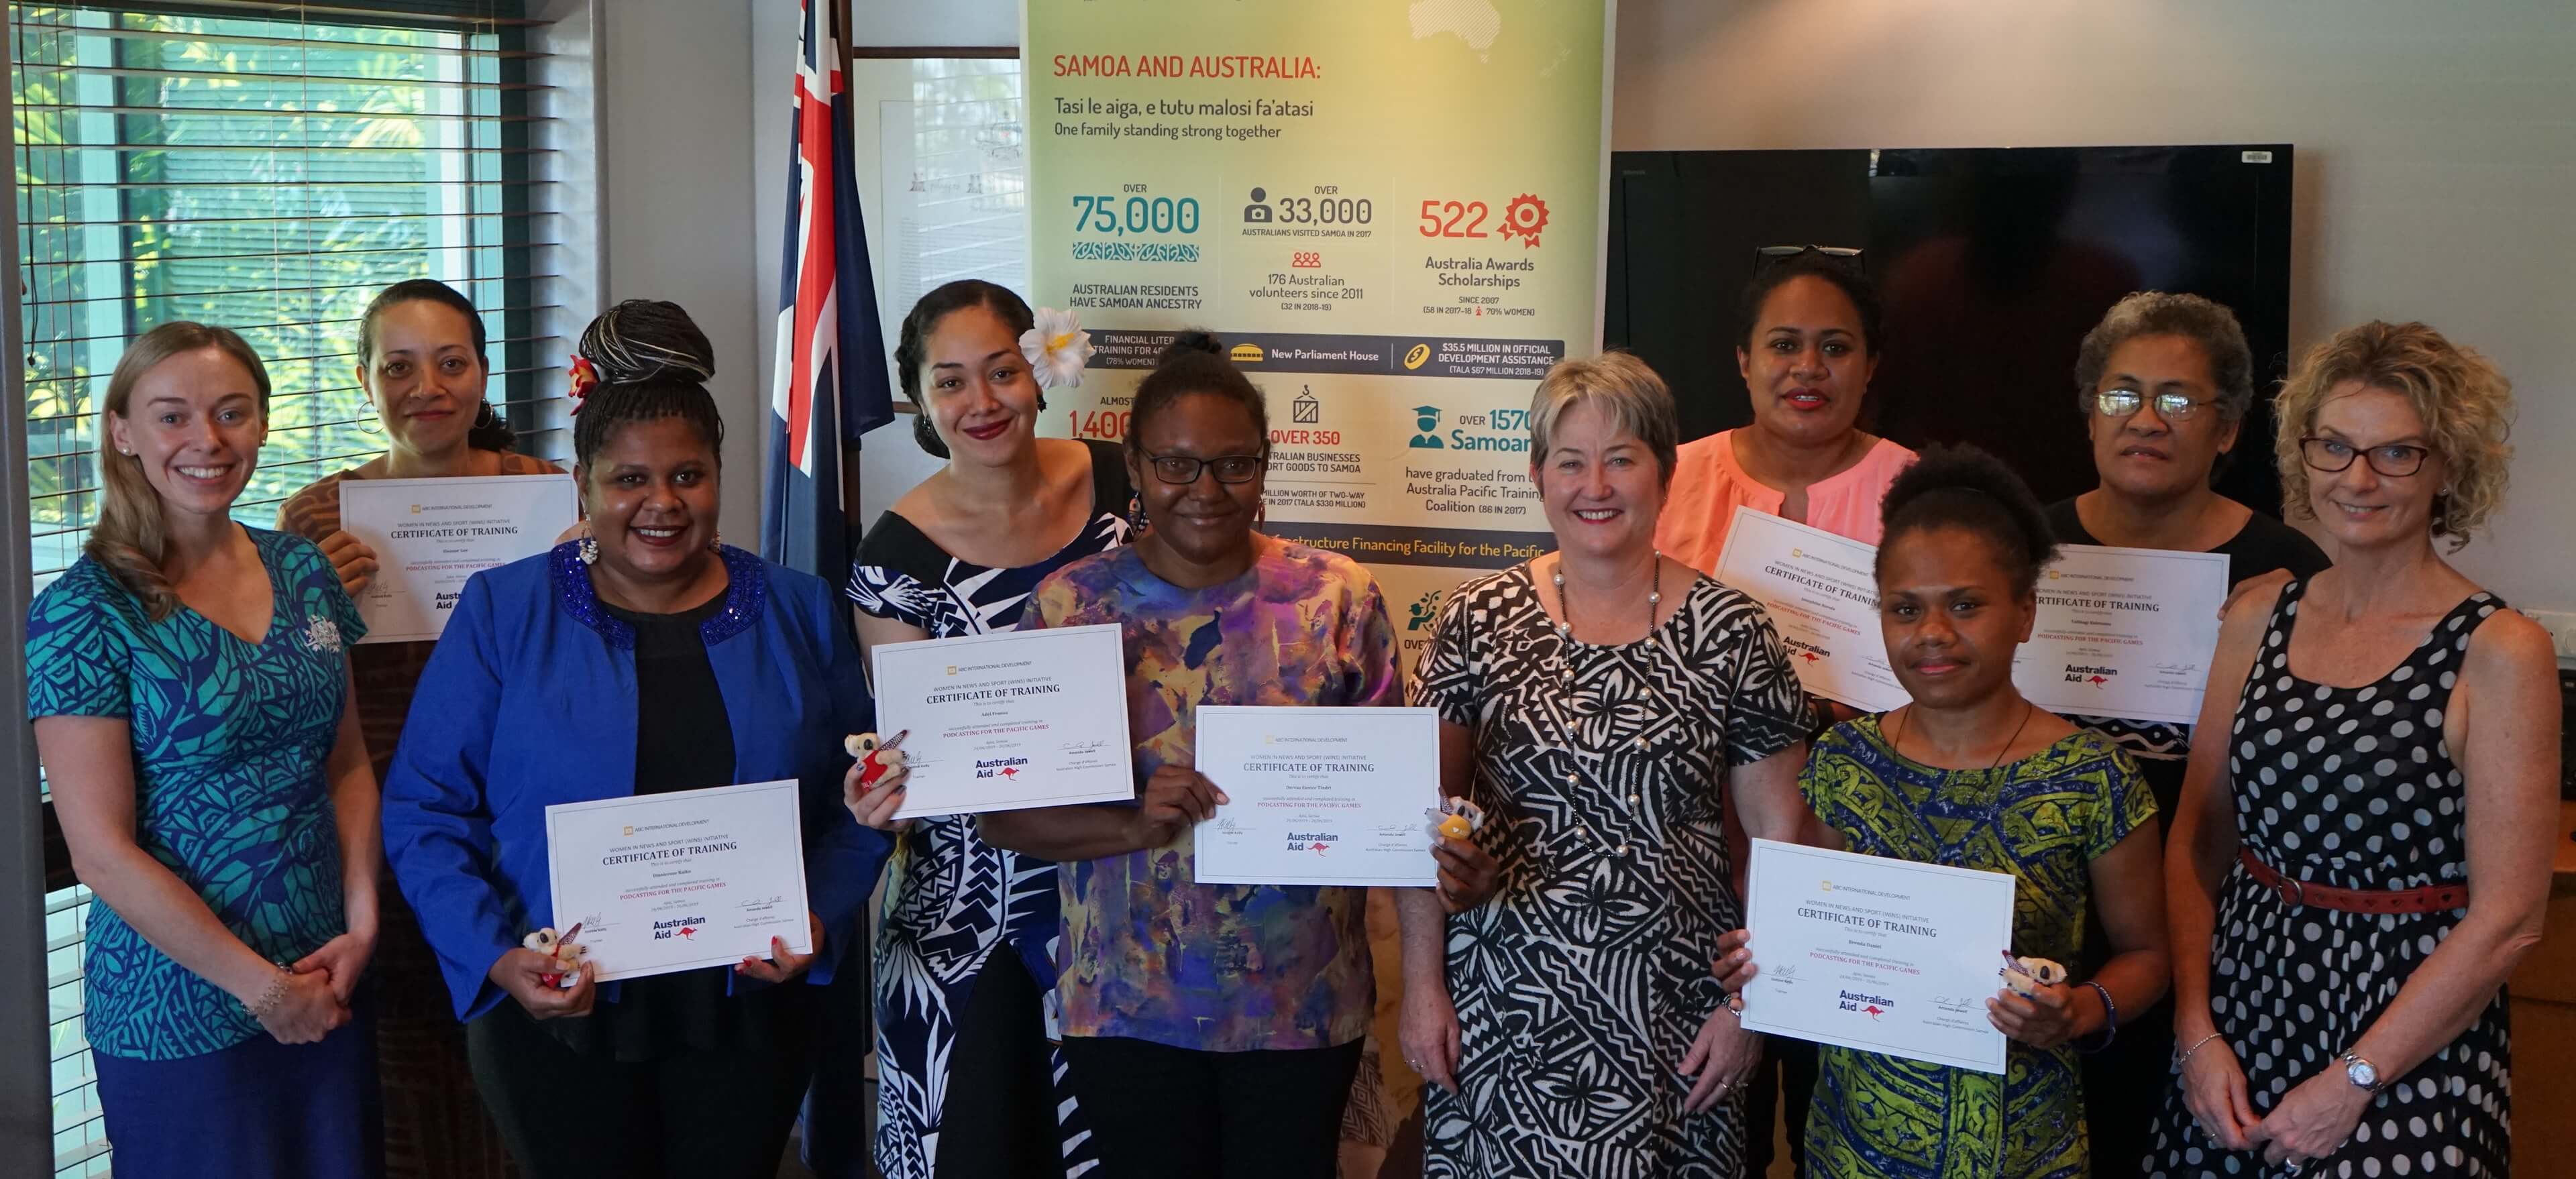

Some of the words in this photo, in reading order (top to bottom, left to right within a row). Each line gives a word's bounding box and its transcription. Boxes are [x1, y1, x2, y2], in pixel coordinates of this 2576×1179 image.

[1054, 54, 1131, 76] SAMOA
[1136, 56, 1183, 78] AND
[1189, 56, 1320, 78] AUSTRALIA:
[1055, 97, 1083, 114] Tasi
[1088, 97, 1102, 114] le
[1106, 99, 1142, 119] aiga,
[1146, 103, 1156, 114] e
[1160, 99, 1194, 115] tutu
[1199, 99, 1251, 116] malosi
[1055, 122, 1078, 135] One
[1081, 122, 1120, 139] family
[1124, 123, 1179, 139] standing
[1182, 124, 1222, 140] strong
[1226, 125, 1281, 141] together
[1124, 184, 1147, 192] OVER
[1314, 186, 1338, 194] OVER
[1073, 196, 1199, 236] 75,000
[1279, 198, 1372, 225] 33,000
[1419, 201, 1488, 237] 522
[1426, 256, 1482, 269] Australia
[1486, 258, 1534, 271] Awards
[1268, 274, 1286, 284] 176
[1289, 274, 1344, 286] Australian
[1438, 273, 1520, 290] Scholarships
[1073, 284, 1138, 295] AUSTRALIAN
[1140, 286, 1198, 296] RESIDENTS
[1250, 286, 1307, 298] volunteers
[1311, 288, 1338, 298] since
[1342, 288, 1363, 299] 2011
[1070, 296, 1096, 307] HAVE
[1099, 298, 1143, 308] SAMOAN
[1146, 299, 1202, 309] ANCESTRY
[1481, 296, 1499, 304] 2007
[1106, 335, 1148, 344] FINANCIAL
[1151, 336, 1175, 345] LITER
[1094, 345, 1132, 354] TRAINING
[1442, 343, 1465, 352] $35.5
[1467, 344, 1499, 353] MILLION
[1503, 345, 1511, 353] IN
[1513, 345, 1550, 354] OFFICIAL
[1272, 349, 1292, 359] New
[1295, 349, 1347, 360] Parliament
[1350, 351, 1379, 361] House
[1439, 354, 1499, 364] DEVELOPMENT
[1502, 355, 1554, 365] ASSISTANCE
[1450, 366, 1469, 374] (TALA
[1486, 367, 1513, 375] MILLION
[1515, 368, 1544, 376] 2018-19)
[1100, 397, 1133, 405] ALMOST
[1460, 416, 1485, 425] OVER
[1271, 430, 1309, 444] OVER
[1313, 431, 1340, 445] 350
[1307, 453, 1360, 462] BUSINESSES
[1286, 463, 1315, 471] GOODS
[1317, 464, 1328, 472] TO
[1330, 465, 1360, 473] SAMOA
[1405, 466, 1433, 479] have
[1436, 468, 1493, 482] graduated
[1497, 470, 1525, 482] from
[1407, 483, 1456, 496] Australia
[1460, 484, 1497, 498] Pacific
[1335, 500, 1366, 508] MILLION)
[1426, 500, 1474, 512] Coalition
[1479, 506, 1493, 514] (86
[1505, 506, 1526, 514] 2017)
[391, 528, 453, 539] CERTIFICATE
[456, 528, 468, 536] OF
[471, 526, 518, 535] TRAINING
[1352, 537, 1411, 555] Financing
[1414, 540, 1456, 557] Facility
[1458, 542, 1477, 555] for
[1480, 543, 1501, 556] the
[1766, 565, 1824, 590] CERTIFICATE
[1825, 585, 1838, 594] OF
[1840, 589, 1879, 606] TRAININ
[2039, 596, 2091, 607] RTIFICATE
[2109, 602, 2159, 612] TRAINING
[1783, 636, 1830, 657] Australian
[2065, 664, 2117, 675] Australian
[2065, 673, 2082, 682] Aid
[926, 690, 993, 704] CERTIFICATE
[995, 689, 1008, 697] OF
[1010, 684, 1060, 695] TRAINING
[943, 728, 979, 738] PODCASTING
[975, 757, 1028, 768] Australian
[1244, 763, 1307, 771] CERTIFICATE
[1309, 763, 1322, 771] OF
[1326, 763, 1375, 772] TRAINING
[977, 769, 993, 778] Aid
[1287, 832, 1338, 841] Australian
[603, 850, 669, 866] CERTIFICATE
[672, 848, 685, 856] OF
[688, 842, 737, 855] TRAINING
[620, 889, 657, 900] PODCASTING
[653, 916, 706, 930] Australian
[1798, 907, 1865, 926] CERTIFICATE
[1868, 918, 1881, 928] OF
[1884, 921, 1937, 938] TRAINING
[655, 930, 671, 940] Aid
[1810, 952, 1847, 963] PODCASTING
[1876, 962, 1898, 971] PACIFIC
[1899, 967, 1921, 975] GAMES
[1839, 990, 1894, 1007] Australian
[1839, 1001, 1856, 1011] Aid
